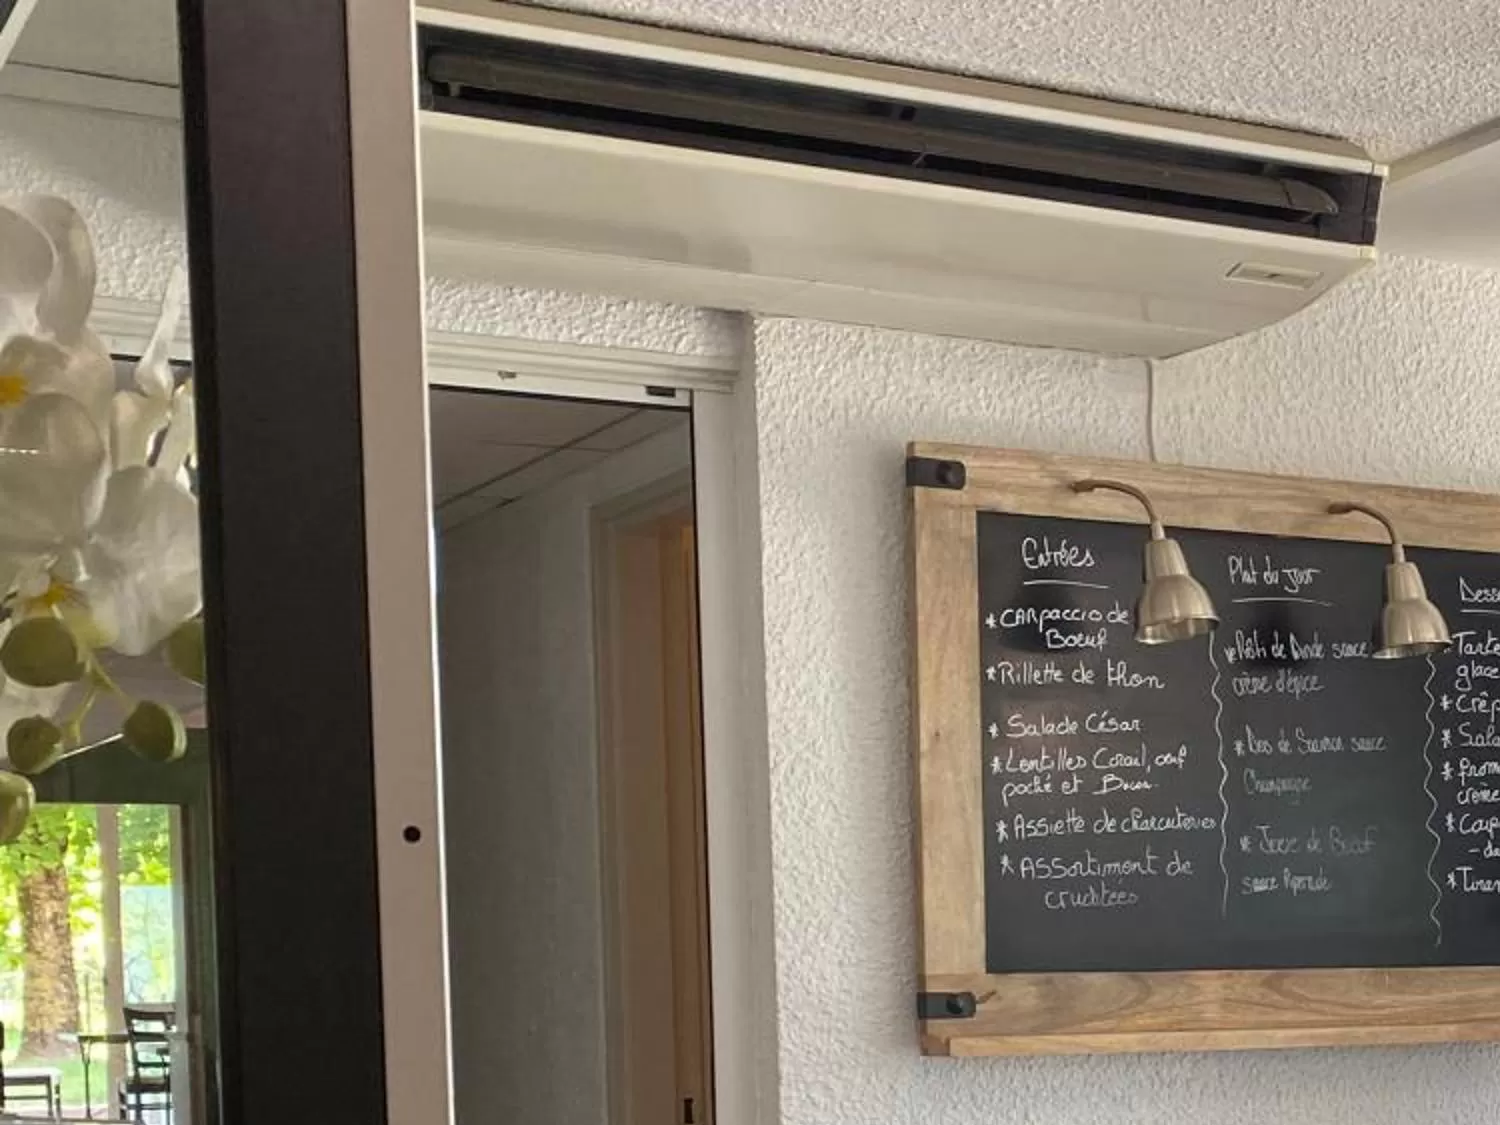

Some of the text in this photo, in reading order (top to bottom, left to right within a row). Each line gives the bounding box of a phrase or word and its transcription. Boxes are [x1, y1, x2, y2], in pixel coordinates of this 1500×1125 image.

[1021, 537, 1095, 569] Entrées
[1228, 555, 1260, 585] Plat
[1263, 555, 1279, 585] du
[1106, 601, 1129, 624] de
[1271, 630, 1287, 660] de
[999, 661, 1065, 685] Rillette
[1071, 661, 1095, 684] de
[1456, 660, 1500, 692] glace
[1006, 710, 1142, 738] Salade César
[1005, 744, 1087, 774] Lentilles
[1001, 773, 1053, 807] poché
[1061, 775, 1084, 794] et
[1093, 807, 1117, 833] de
[1165, 850, 1193, 877] de
